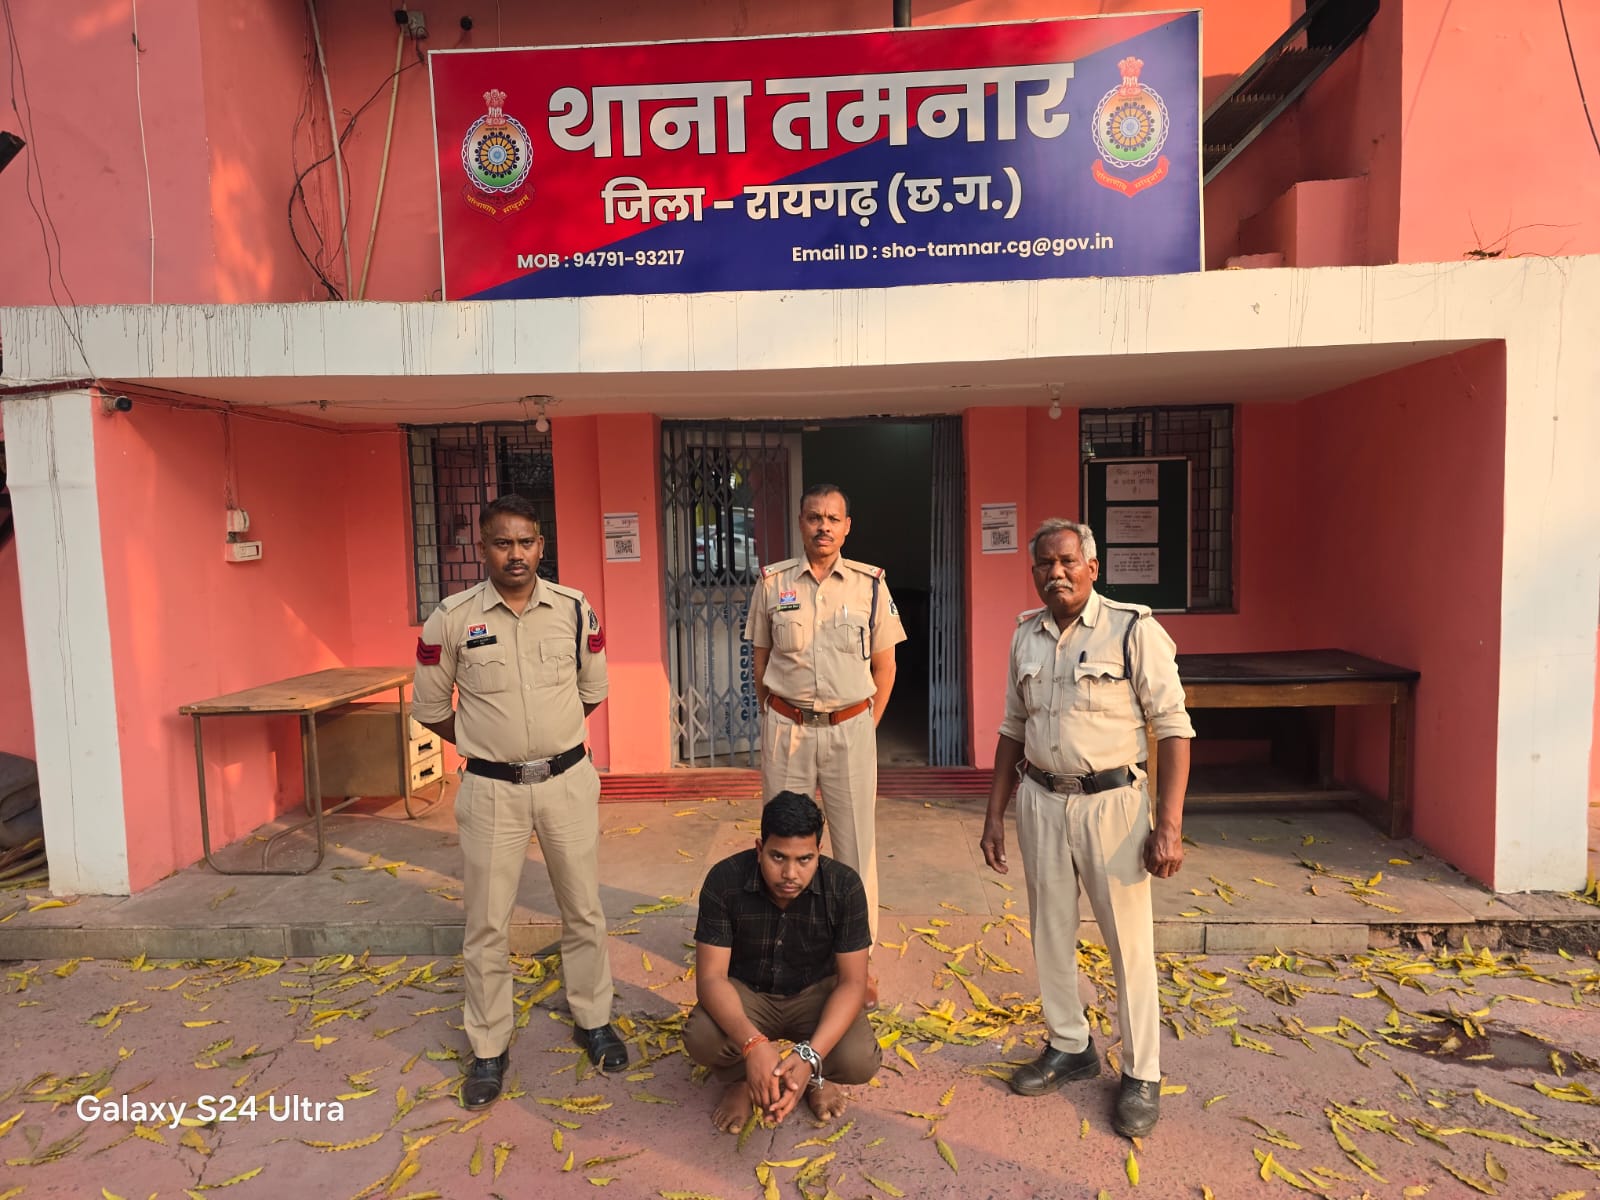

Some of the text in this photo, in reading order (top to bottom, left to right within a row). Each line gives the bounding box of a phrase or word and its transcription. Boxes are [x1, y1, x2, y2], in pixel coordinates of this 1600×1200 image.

[548, 62, 1075, 157] थाना तमनार
[601, 176, 706, 224] जिला
[743, 180, 879, 228] रायगढ़
[887, 167, 1023, 224] (छ.ग.)
[573, 249, 685, 268] 94791-93217
[792, 244, 846, 262] Email
[881, 232, 1115, 259] sho-tamnar.cg@gov.in
